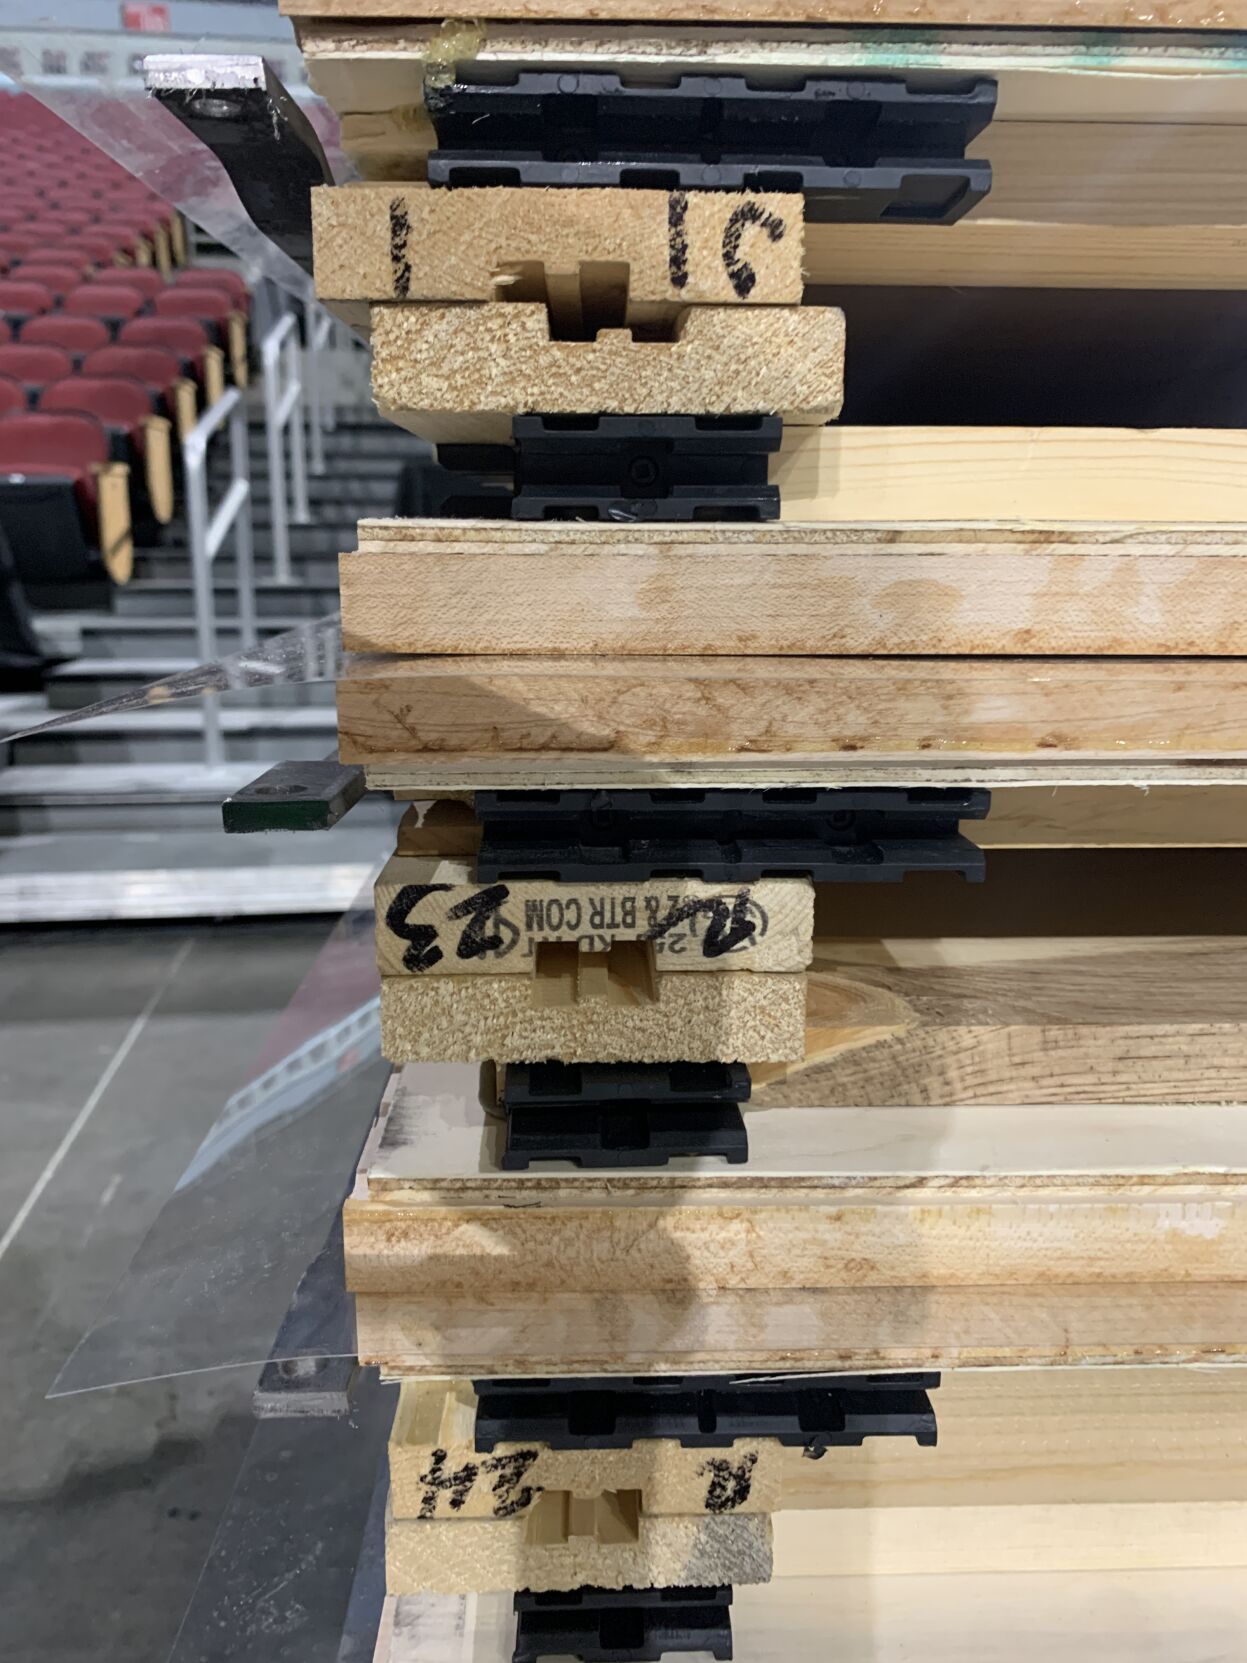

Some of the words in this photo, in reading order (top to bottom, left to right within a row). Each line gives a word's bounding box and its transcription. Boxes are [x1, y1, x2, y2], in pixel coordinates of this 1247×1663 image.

[385, 883, 510, 972] 23
[525, 898, 582, 932] COM
[589, 896, 637, 930] BTR
[419, 1448, 545, 1520] 24
